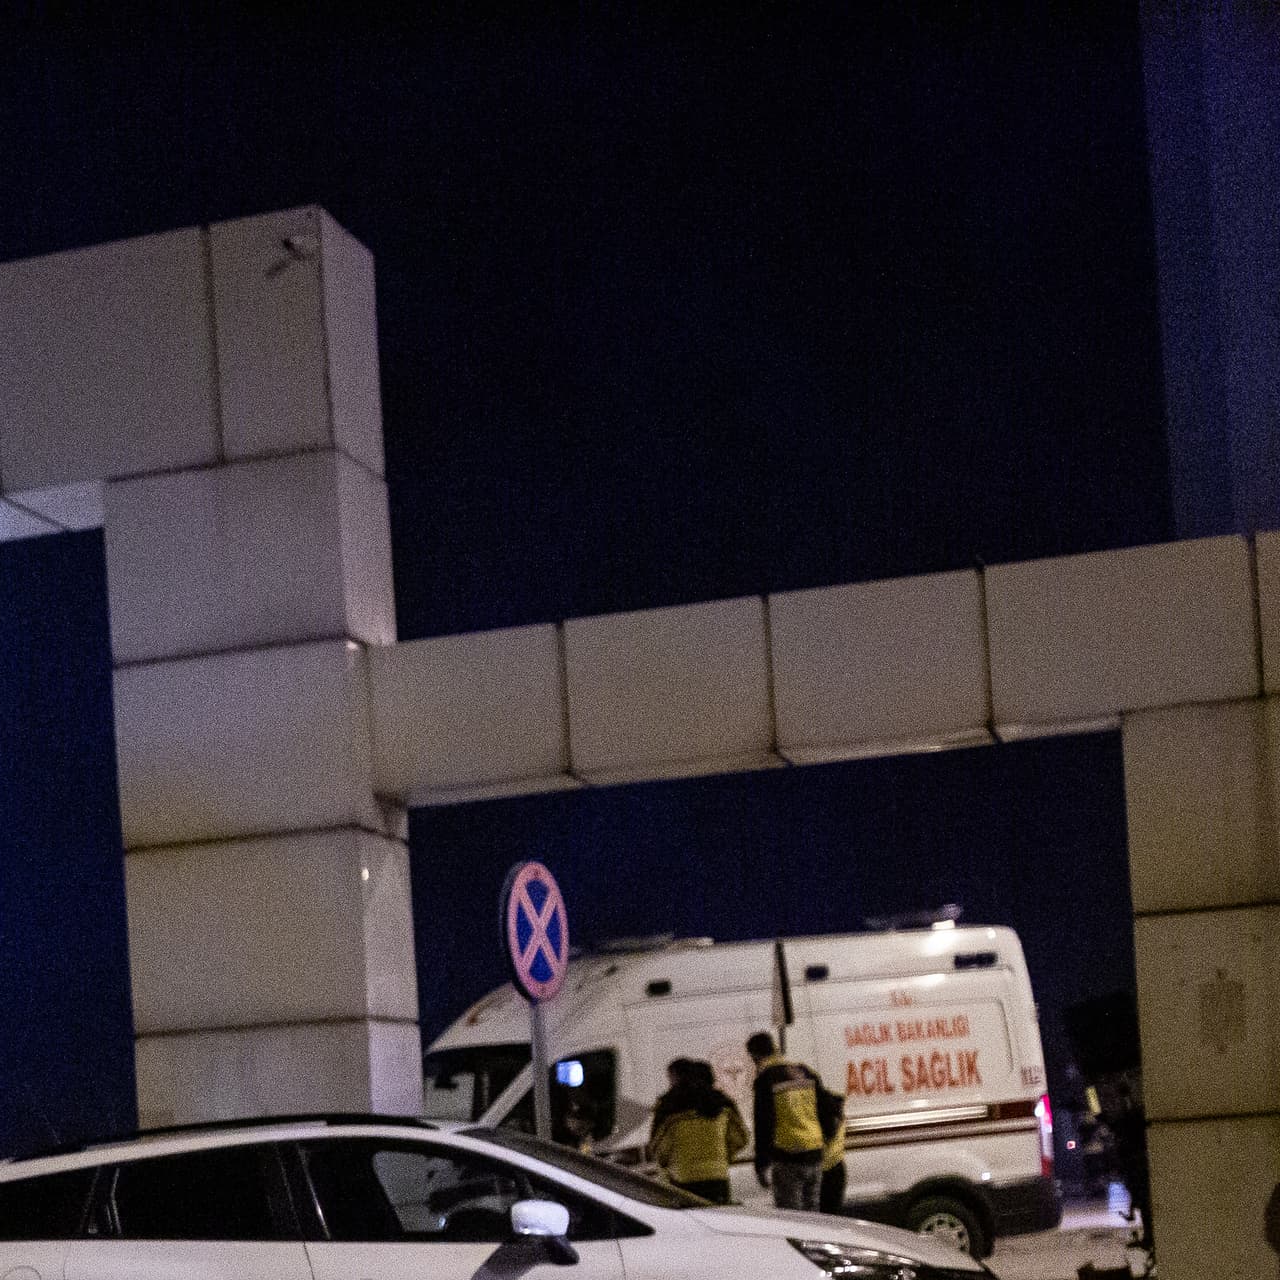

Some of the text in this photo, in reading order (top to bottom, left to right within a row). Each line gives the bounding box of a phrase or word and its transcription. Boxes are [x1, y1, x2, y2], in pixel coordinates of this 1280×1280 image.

[844, 1014, 970, 1048] SAĞLIK BAKANLIĞI
[845, 1049, 982, 1095] ACİL SAĞLIK
